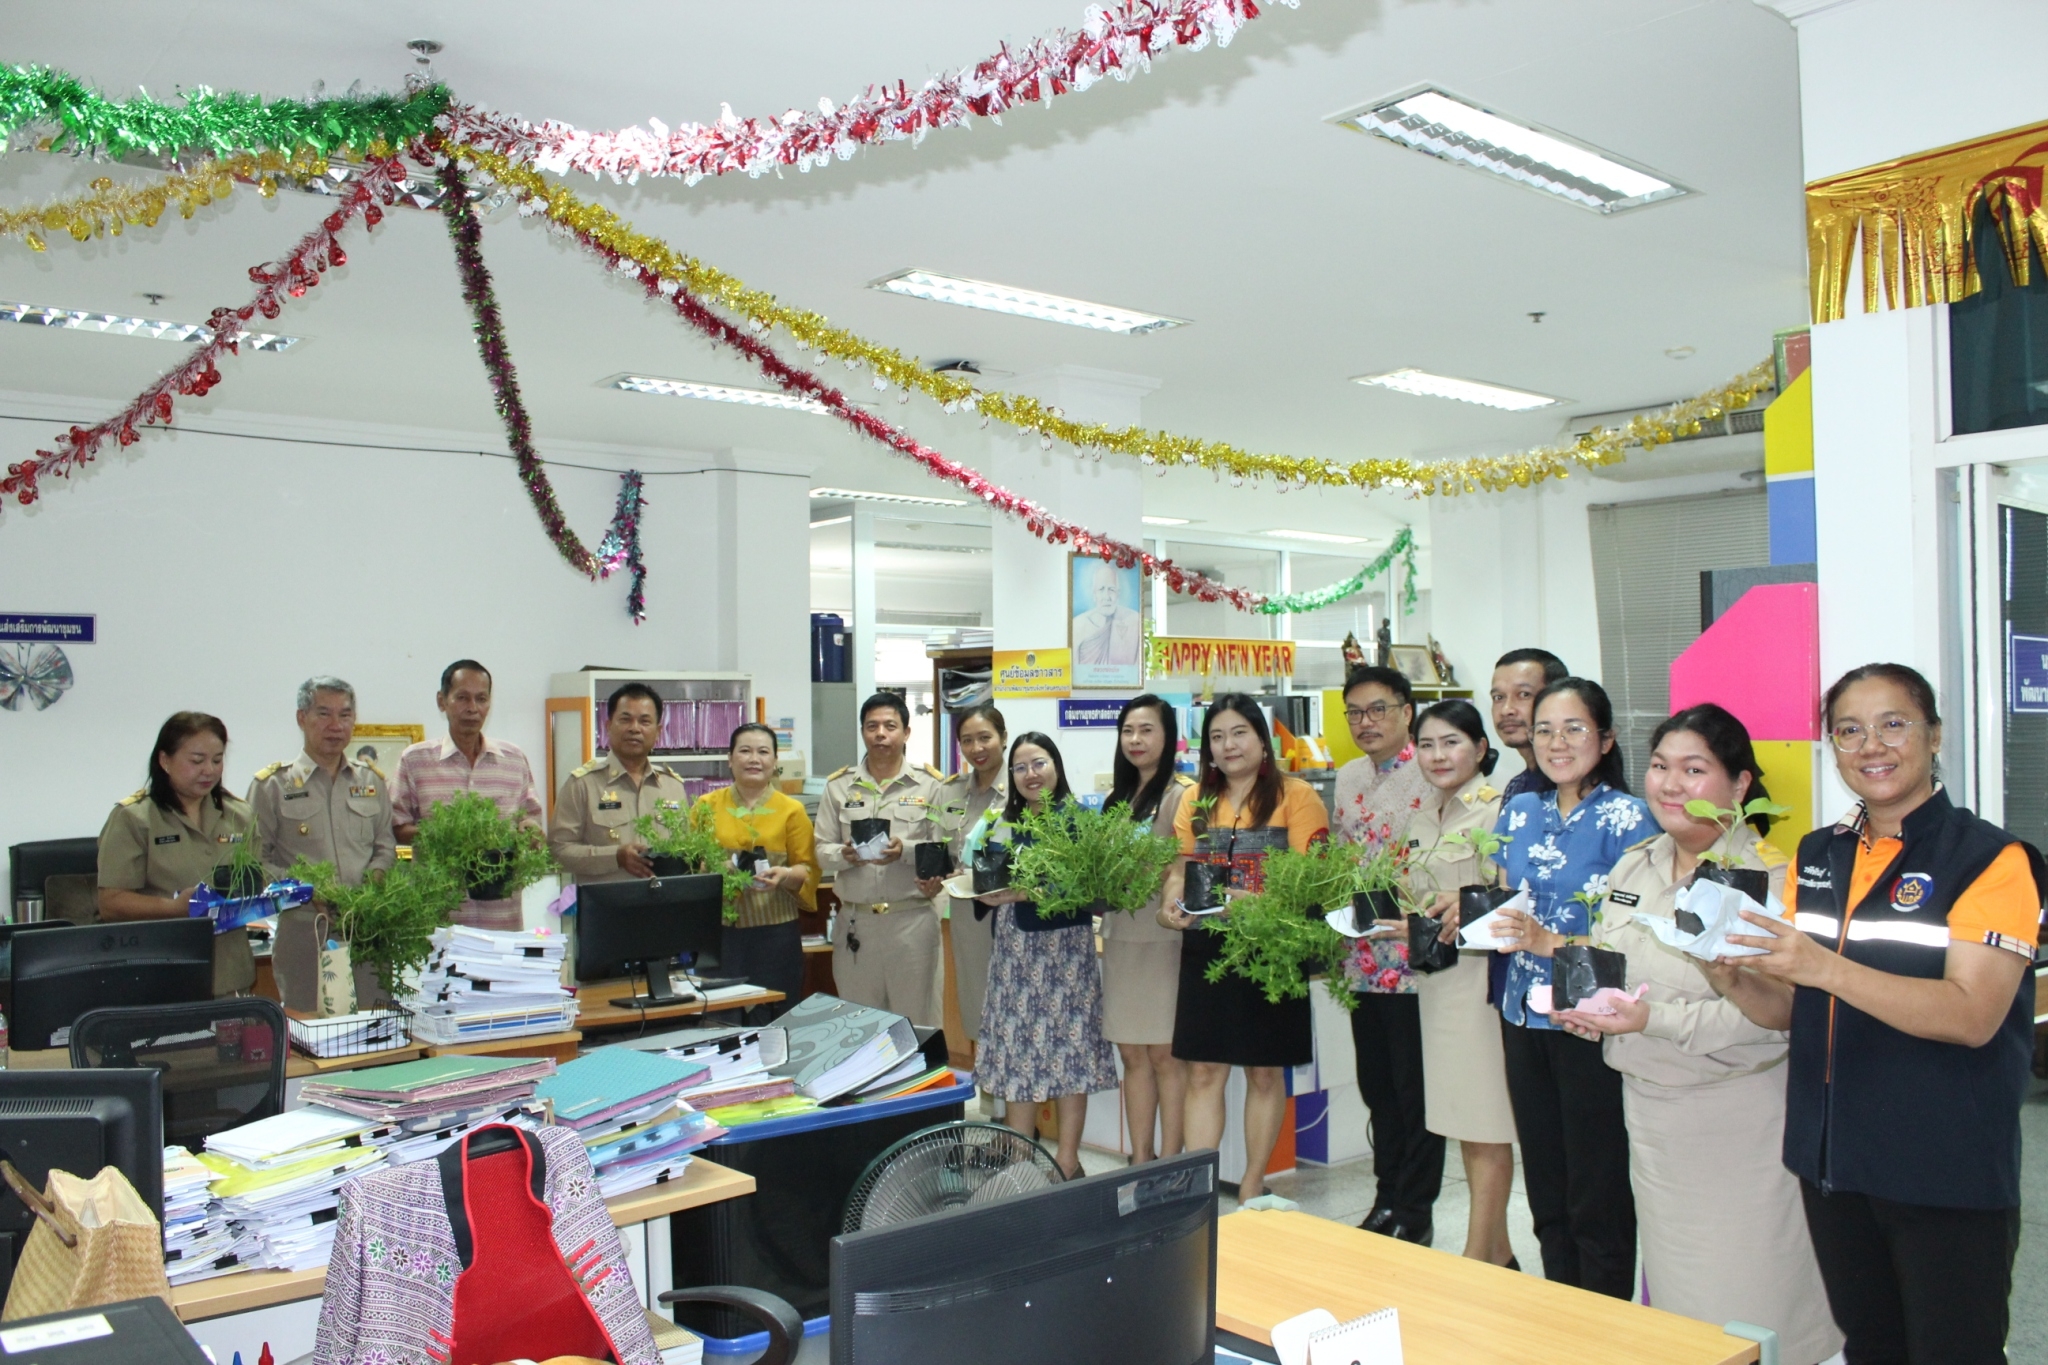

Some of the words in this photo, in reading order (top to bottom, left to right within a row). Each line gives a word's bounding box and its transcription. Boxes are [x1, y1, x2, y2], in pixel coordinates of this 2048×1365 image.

[1216, 643, 1250, 675] NEW
[1251, 644, 1293, 675] YEAR
[120, 936, 139, 948] LG
